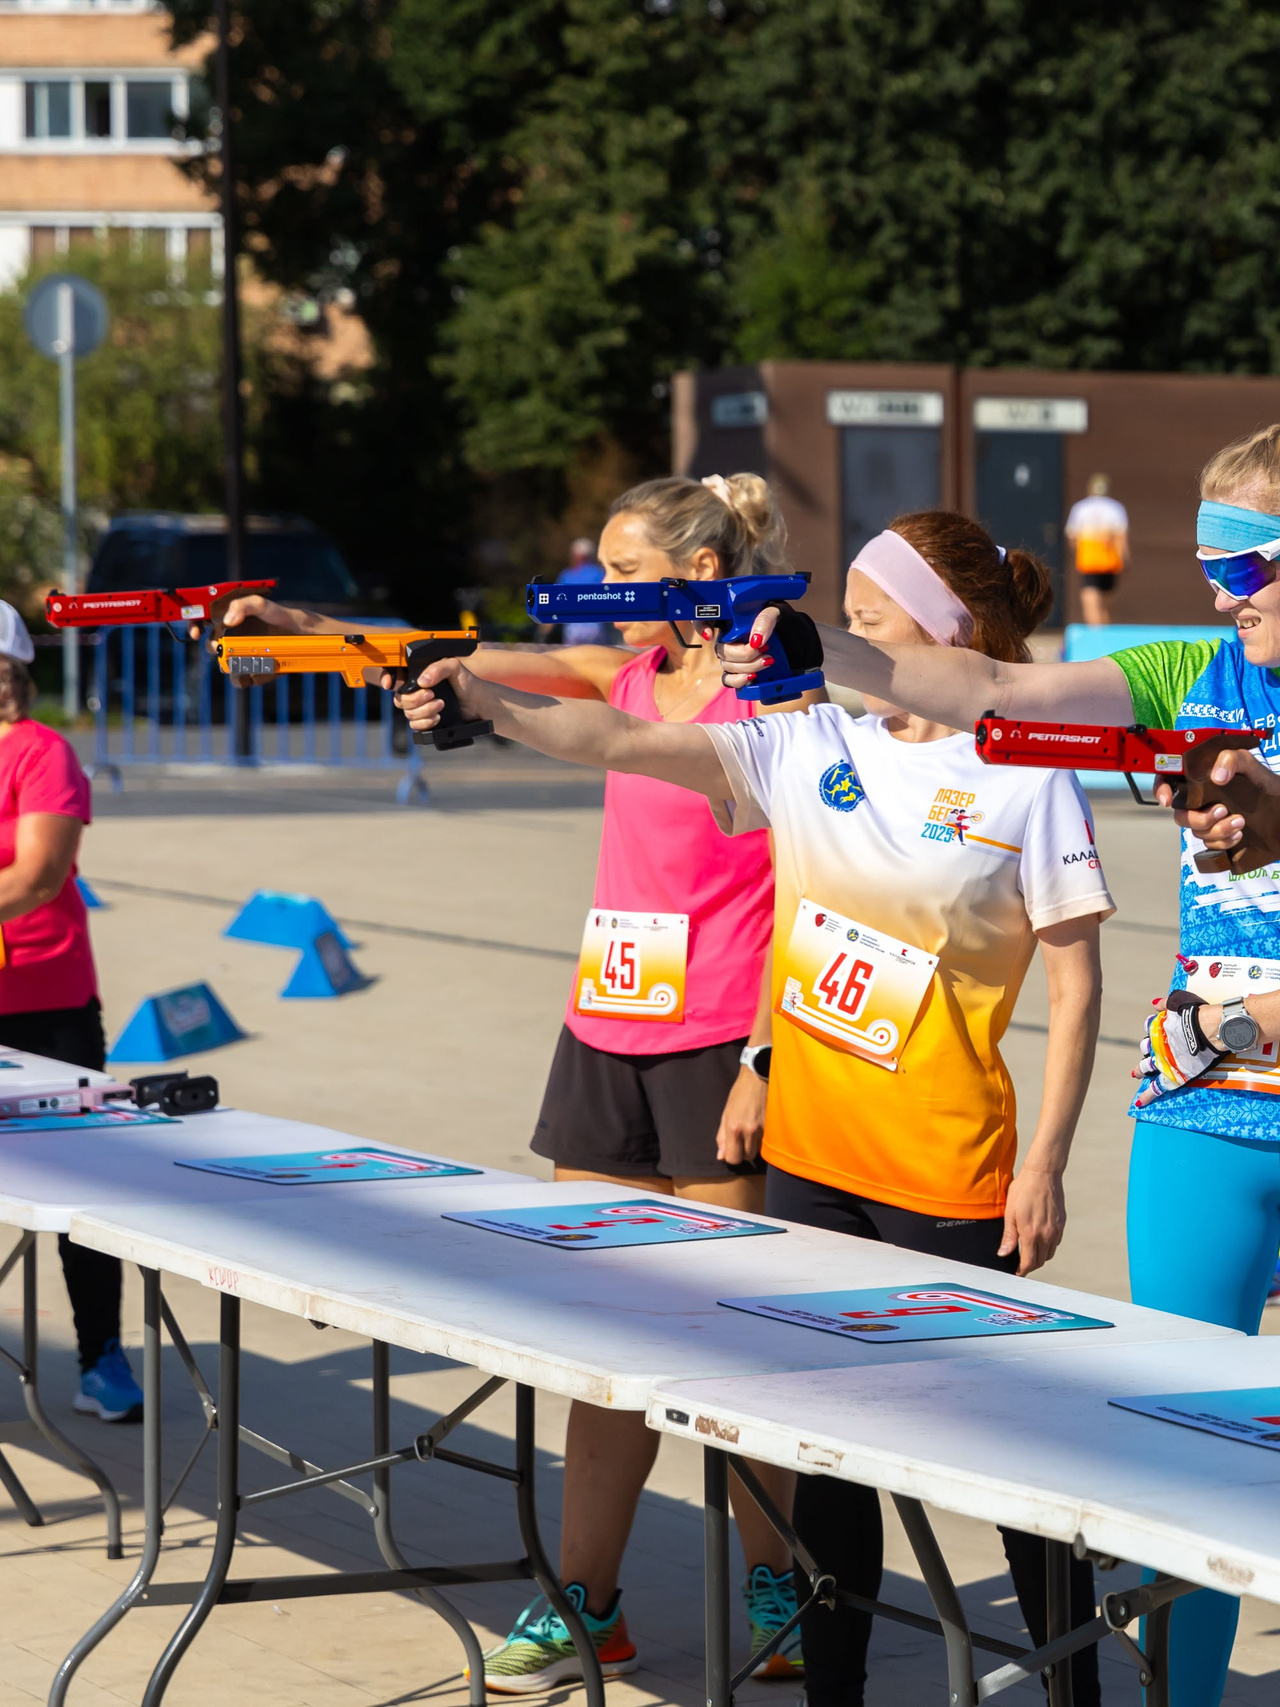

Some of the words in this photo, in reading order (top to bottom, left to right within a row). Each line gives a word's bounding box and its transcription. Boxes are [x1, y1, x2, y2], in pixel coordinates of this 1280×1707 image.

[577, 591, 622, 602] pentashot
[1028, 732, 1101, 745] PENTASHOT
[933, 788, 976, 809] ЛАЗЕР
[921, 822, 954, 843] 2025
[604, 940, 636, 991] 45
[818, 951, 874, 1016] 46
